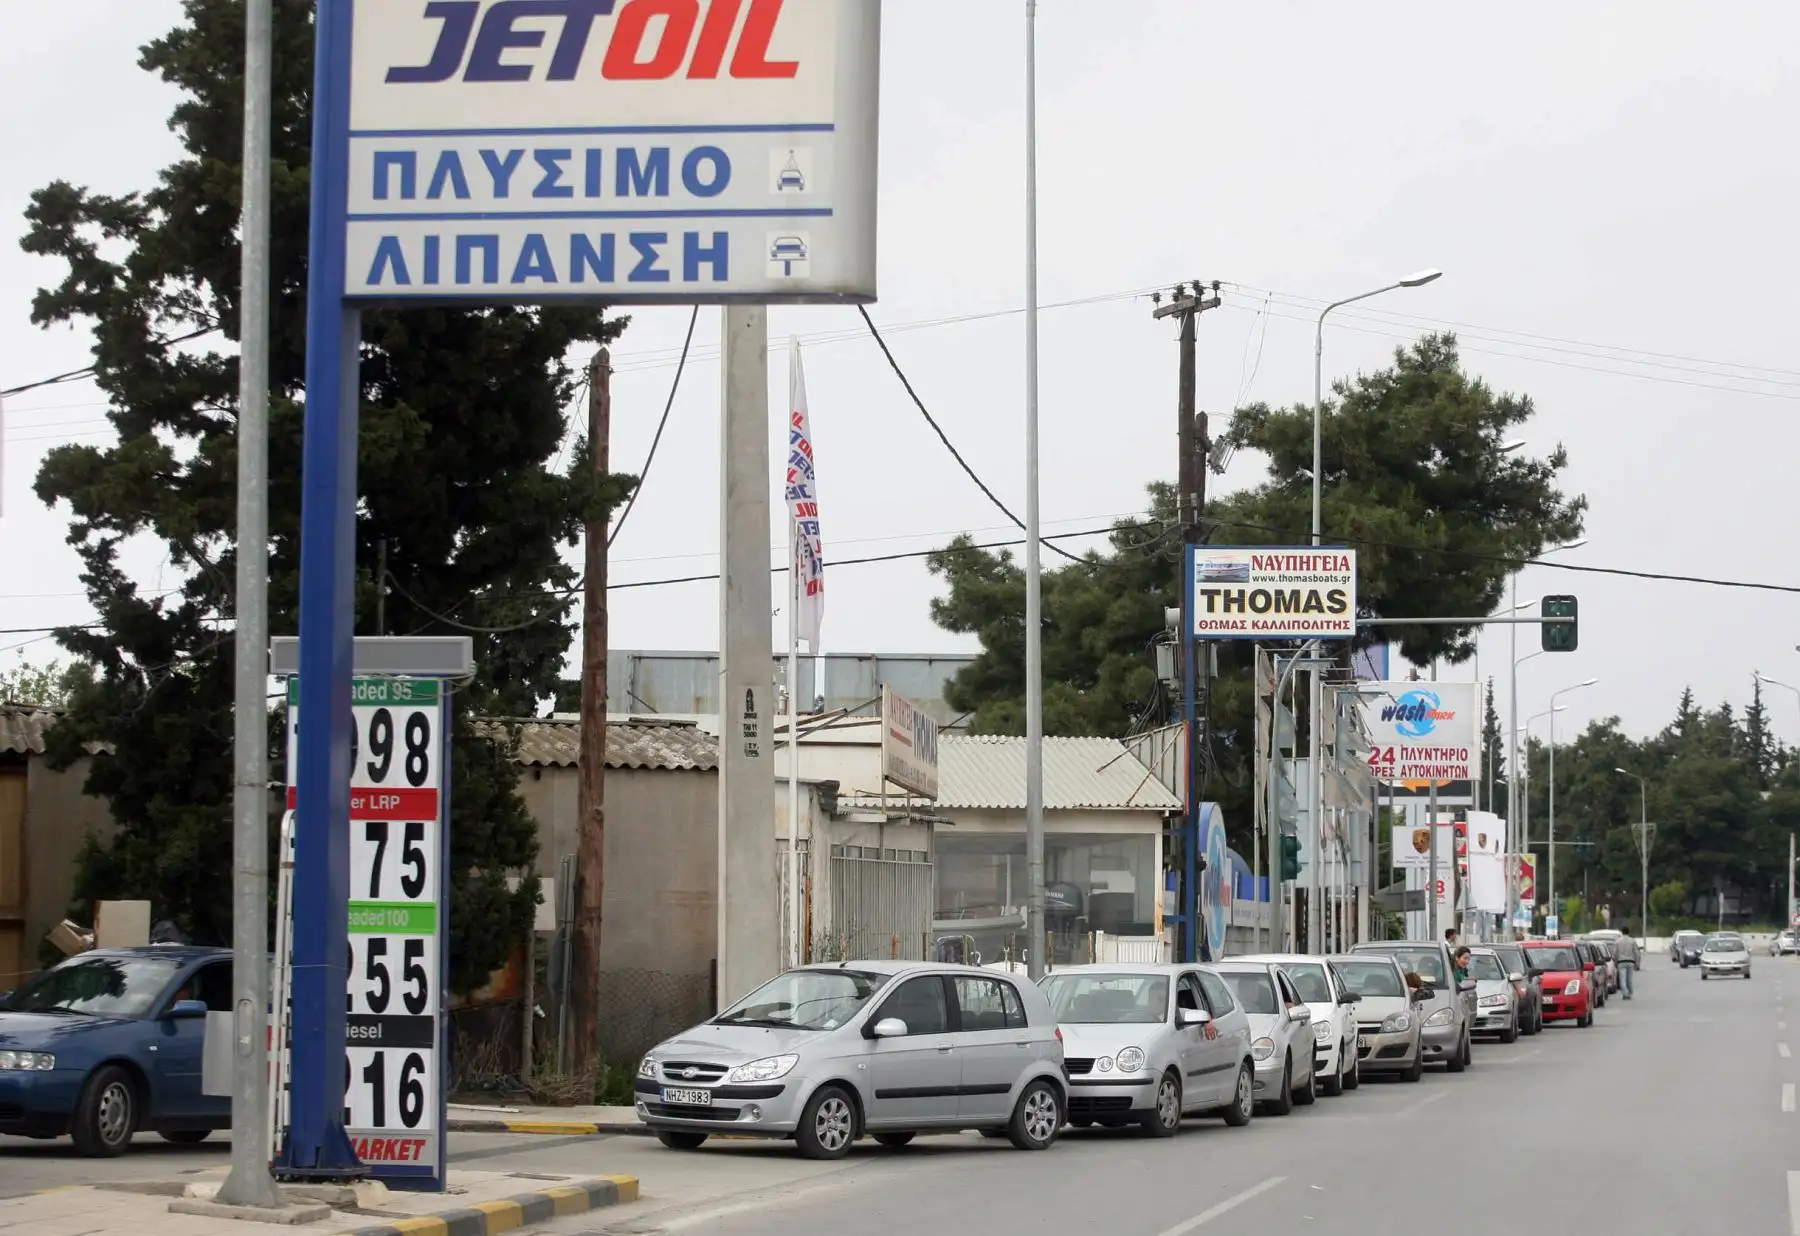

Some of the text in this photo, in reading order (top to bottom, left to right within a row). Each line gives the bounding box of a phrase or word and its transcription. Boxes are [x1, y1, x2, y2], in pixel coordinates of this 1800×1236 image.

[384, 0, 800, 84] JETOIL
[372, 146, 732, 200] ΠΛΥΣΙΜΟ
[366, 231, 729, 286] ΛΙΠΑΝΣΗ
[1251, 555, 1350, 571] ΝΑΥΠΗΓΕΙΑ
[1252, 573, 1351, 584] www.thomasboats.gr
[1200, 588, 1348, 614] THOMAS
[1198, 619, 1350, 630] ΘΩΜΑΣ ΚΑΛΛΙΠΟΛΙΤΗΣ
[392, 682, 412, 700] 95
[351, 708, 430, 787] 98
[1367, 746, 1396, 765] 24
[1400, 747, 1469, 761] ΠΛΥΝΤΗΡΙΟ
[1400, 765, 1469, 778] ΑΥΤΟΚΙΝΗΤΩΝ
[370, 795, 400, 810] LRP
[347, 937, 428, 1015] 55
[345, 1051, 425, 1128] 16
[352, 1138, 427, 1161] ARKET
